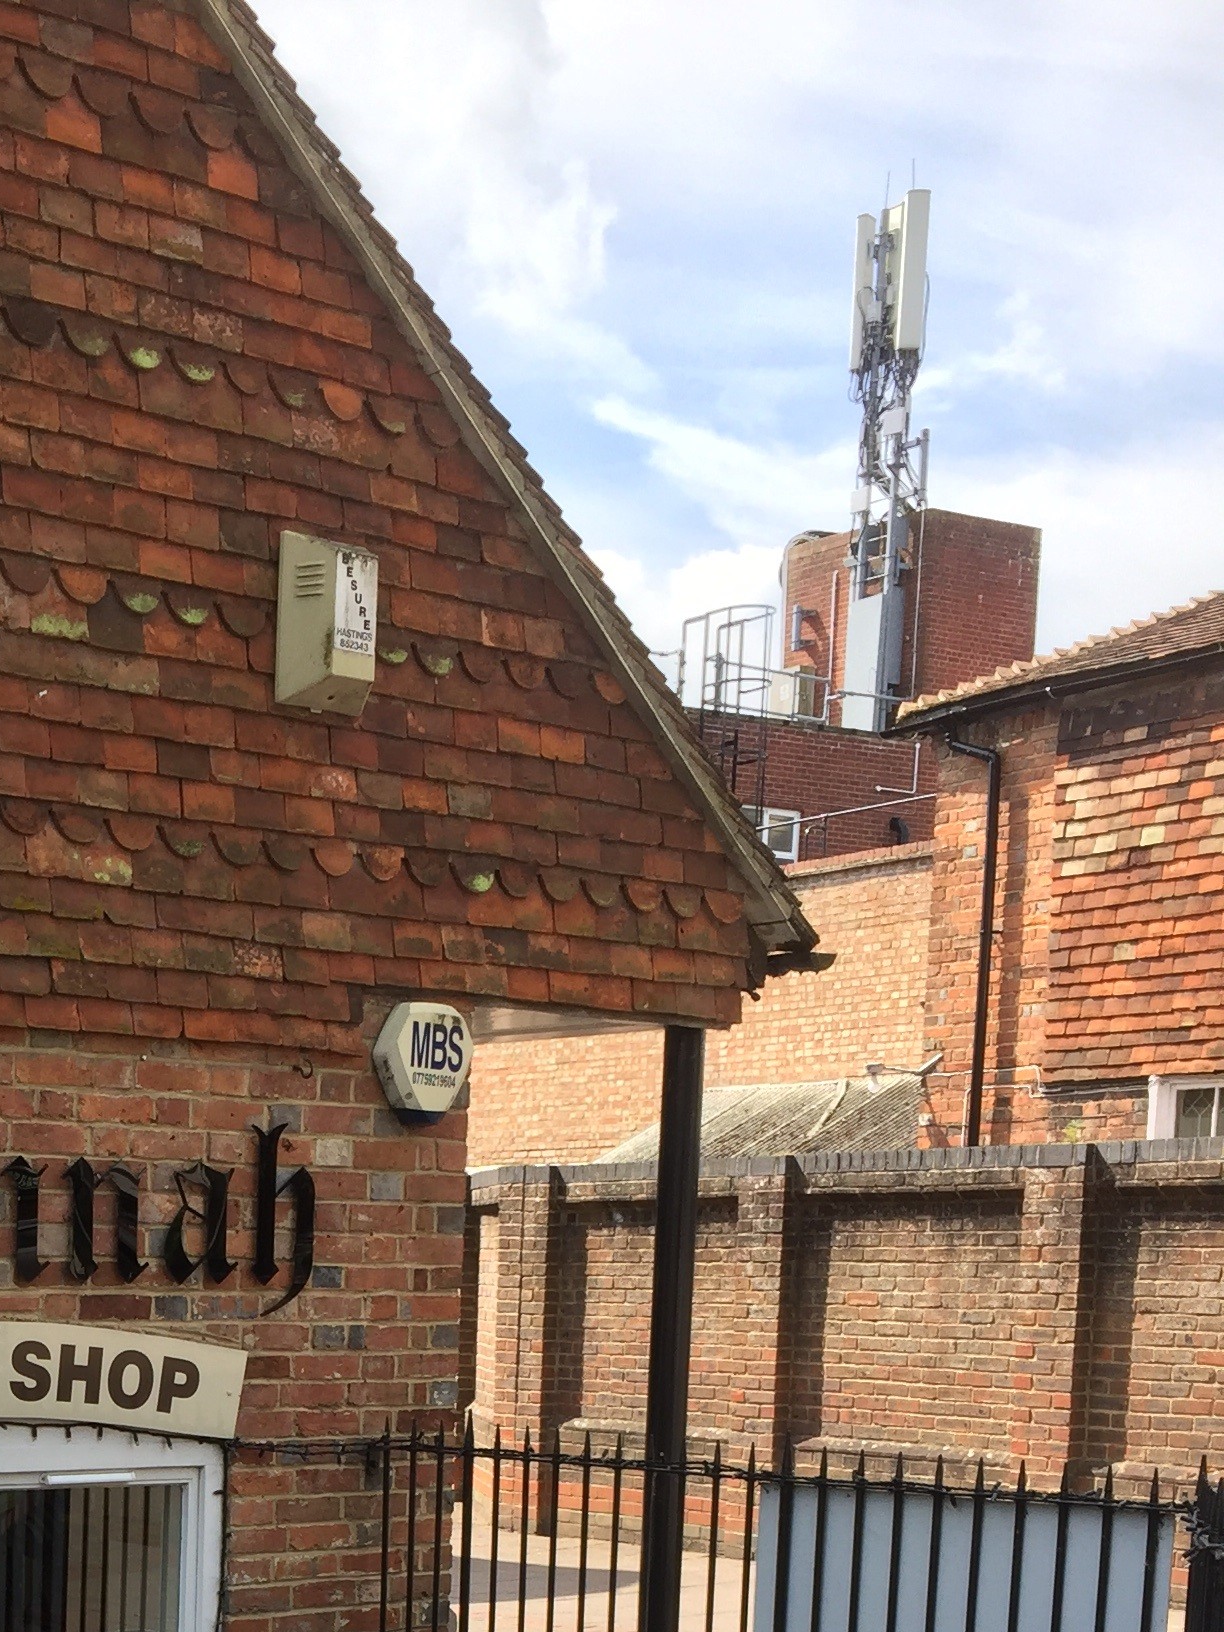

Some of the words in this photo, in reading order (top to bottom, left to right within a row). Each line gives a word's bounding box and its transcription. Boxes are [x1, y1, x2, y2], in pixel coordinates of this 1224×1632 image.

[336, 627, 373, 642] HASTINGS
[410, 1020, 464, 1073] MBS
[9, 1339, 200, 1414] SHOP
